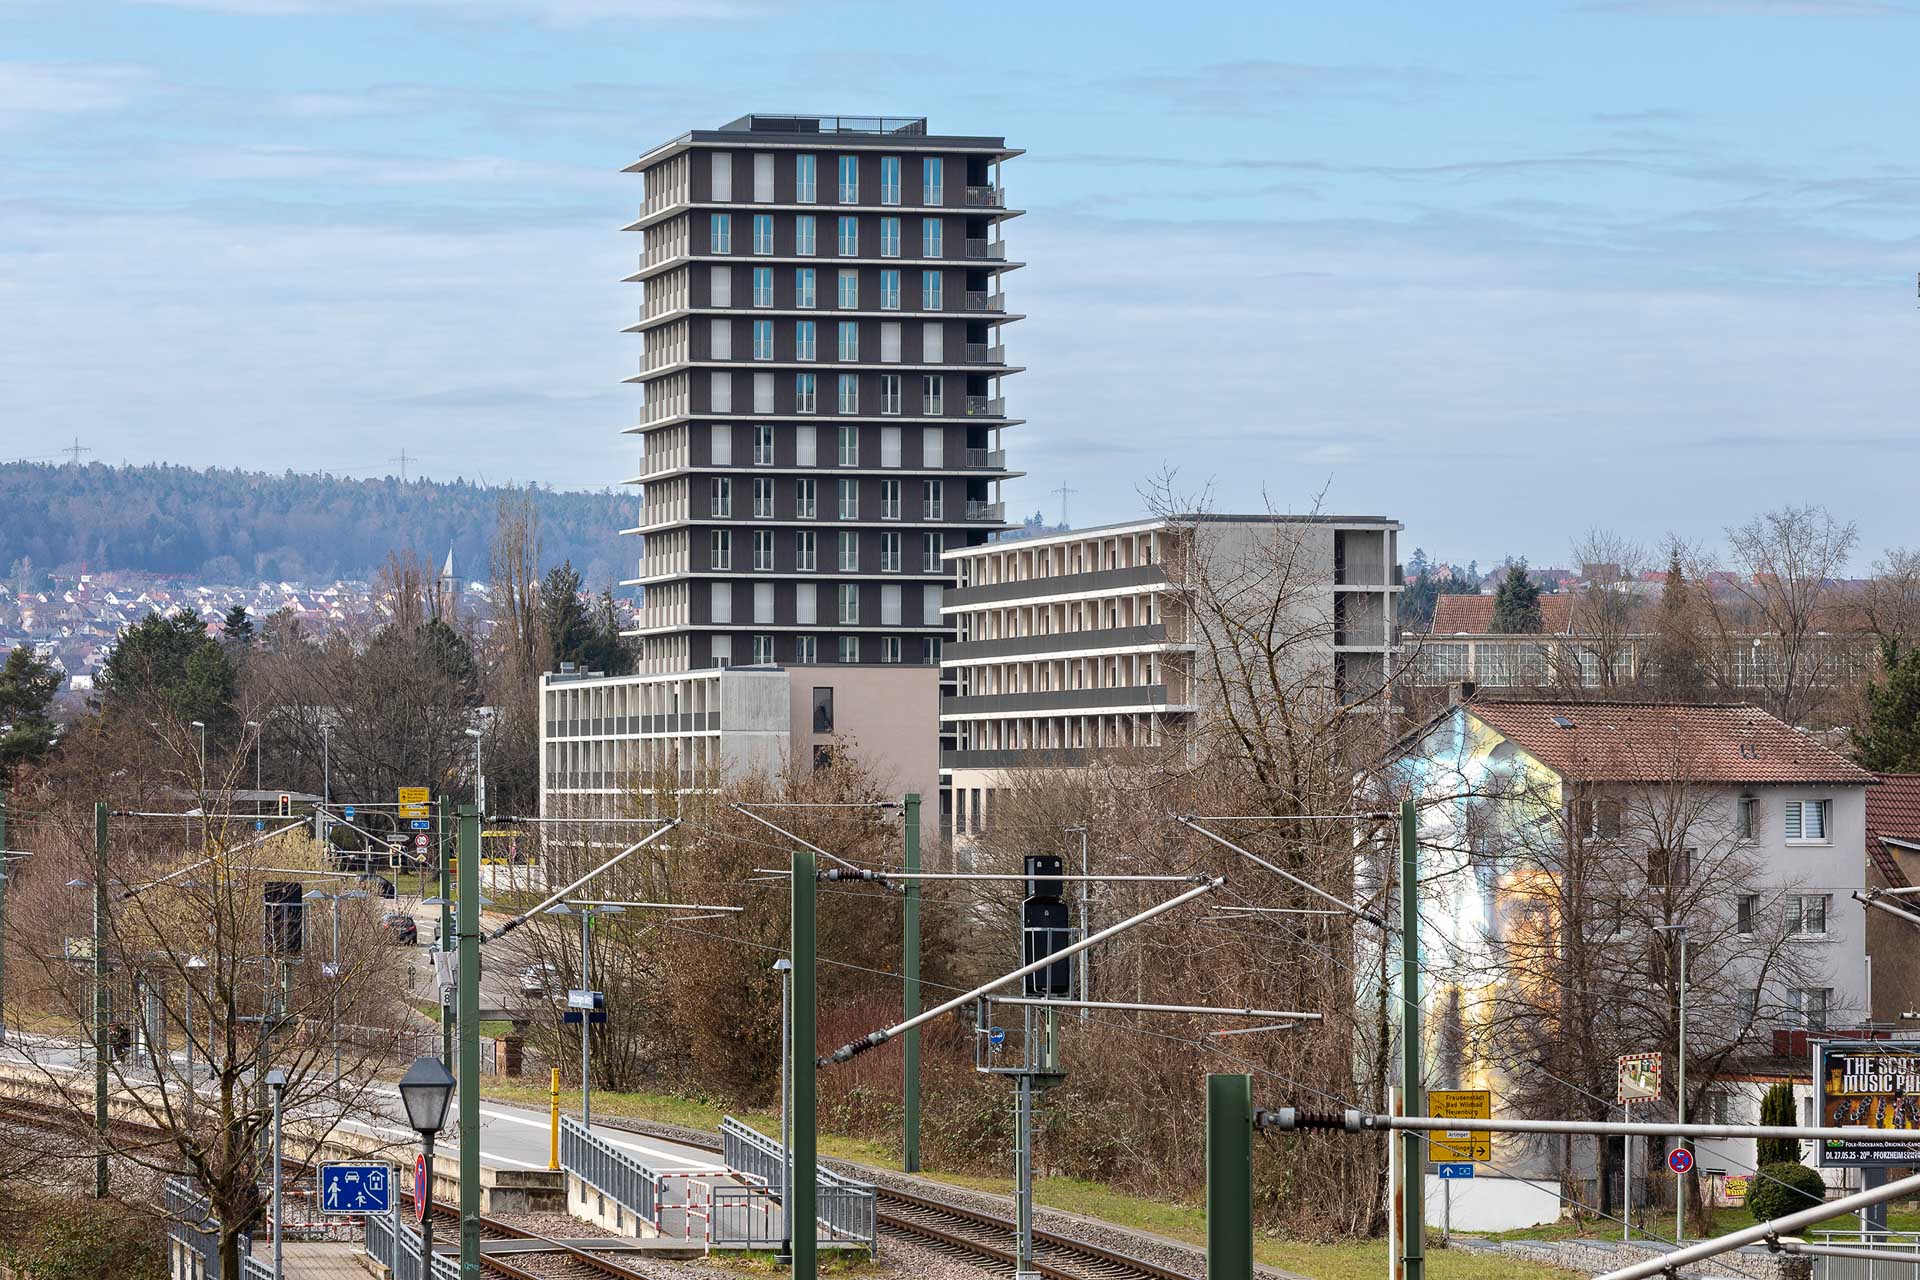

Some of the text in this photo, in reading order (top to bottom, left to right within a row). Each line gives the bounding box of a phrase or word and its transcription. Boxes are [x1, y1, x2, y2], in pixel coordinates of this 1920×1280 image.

[444, 994, 451, 1003] 8
[1843, 1057, 1920, 1075] THE SCOT
[1843, 1075, 1892, 1092] MUSIC
